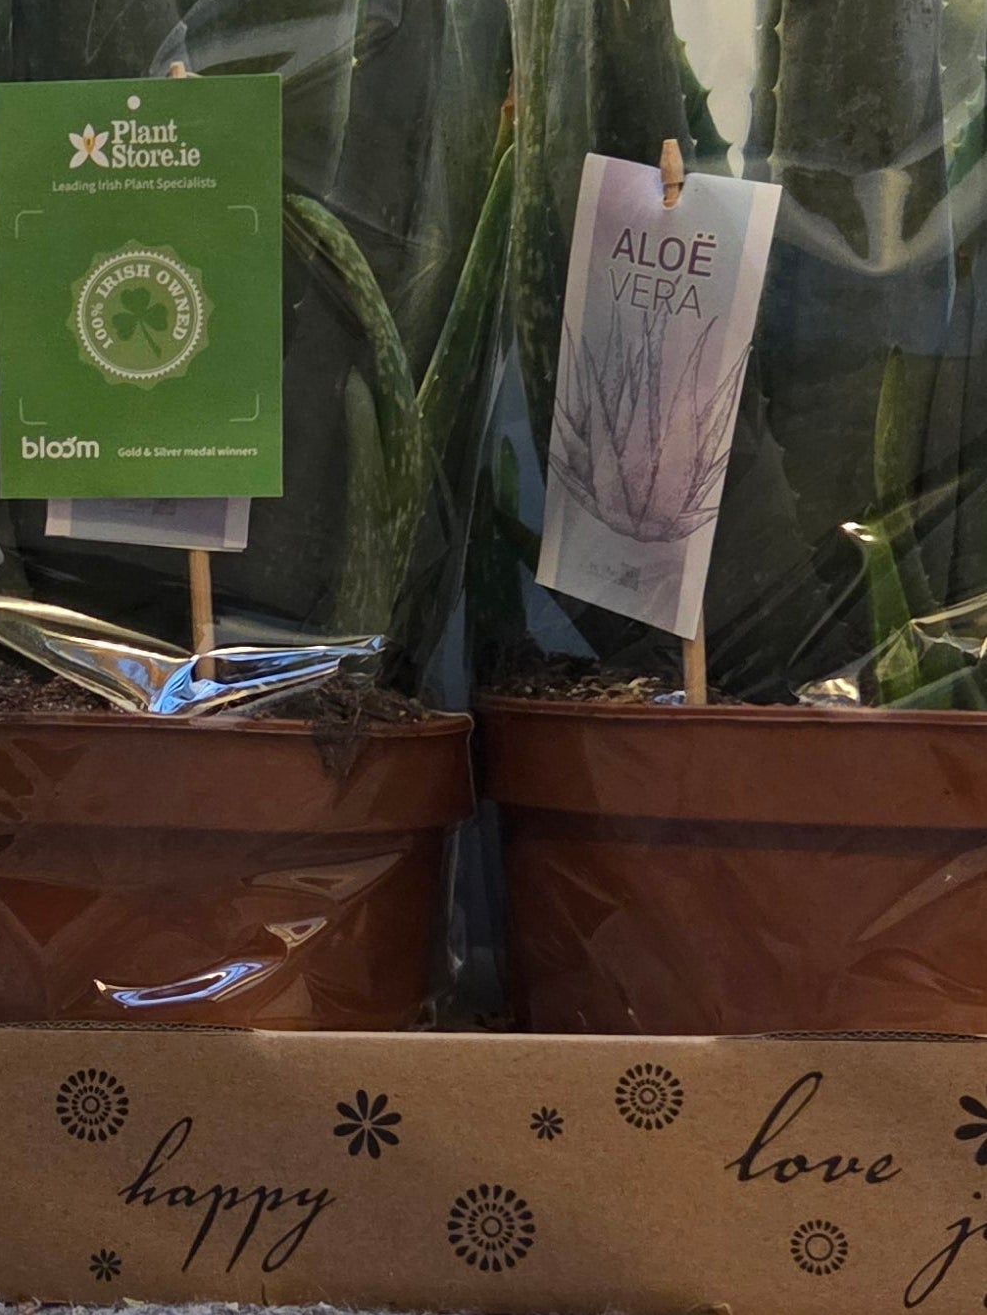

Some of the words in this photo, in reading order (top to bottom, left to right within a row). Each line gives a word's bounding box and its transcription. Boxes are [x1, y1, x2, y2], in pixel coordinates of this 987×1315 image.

[111, 119, 178, 144] Plant
[111, 142, 201, 169] Store.ie
[52, 180, 96, 194] Leading
[98, 179, 122, 191] Irish
[124, 178, 154, 190] Plant
[156, 176, 217, 191] Specialists
[612, 228, 717, 277] ALOË
[95, 264, 151, 298] IRISH
[609, 268, 702, 320] VERA
[91, 302, 114, 349] 100%
[155, 270, 190, 340] OWNED
[21, 436, 100, 459] bloom
[117, 447, 143, 458] Gold
[143, 447, 152, 457] &
[153, 446, 182, 457] Silver
[183, 446, 216, 457] medal
[217, 446, 258, 457] winners
[725, 1071, 903, 1184] love
[118, 1116, 336, 1273] happy
[903, 1190, 987, 1309] j
